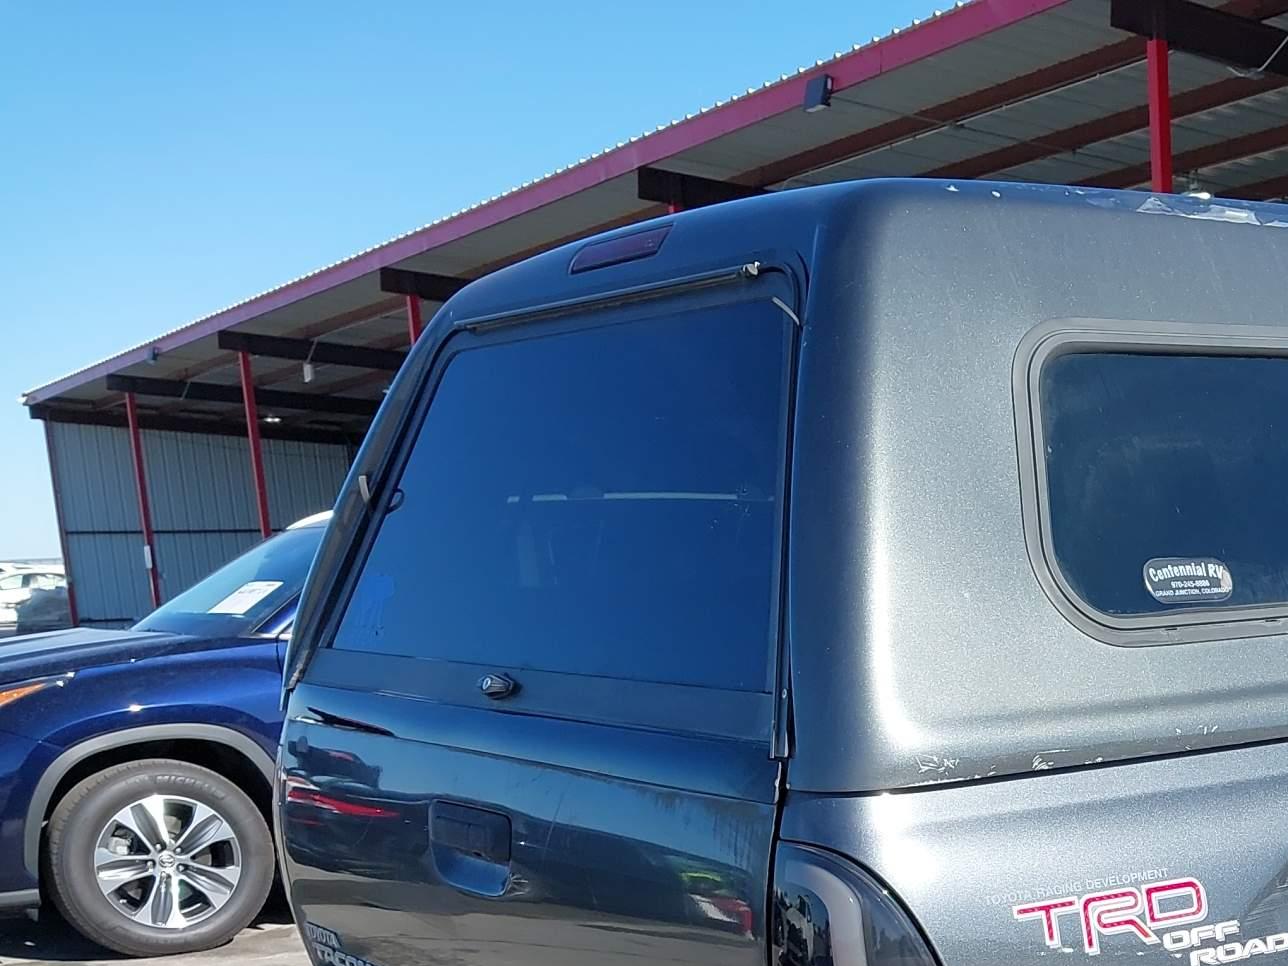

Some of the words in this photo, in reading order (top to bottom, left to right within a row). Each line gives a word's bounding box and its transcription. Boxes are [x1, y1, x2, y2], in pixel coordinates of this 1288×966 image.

[1149, 563, 1206, 581] Centennial
[1207, 564, 1223, 579] RV
[1036, 881, 1082, 899] RACING
[1086, 867, 1169, 889] DEVELOPMENT
[1012, 877, 1208, 955] TRD
[1162, 919, 1241, 952] OFF
